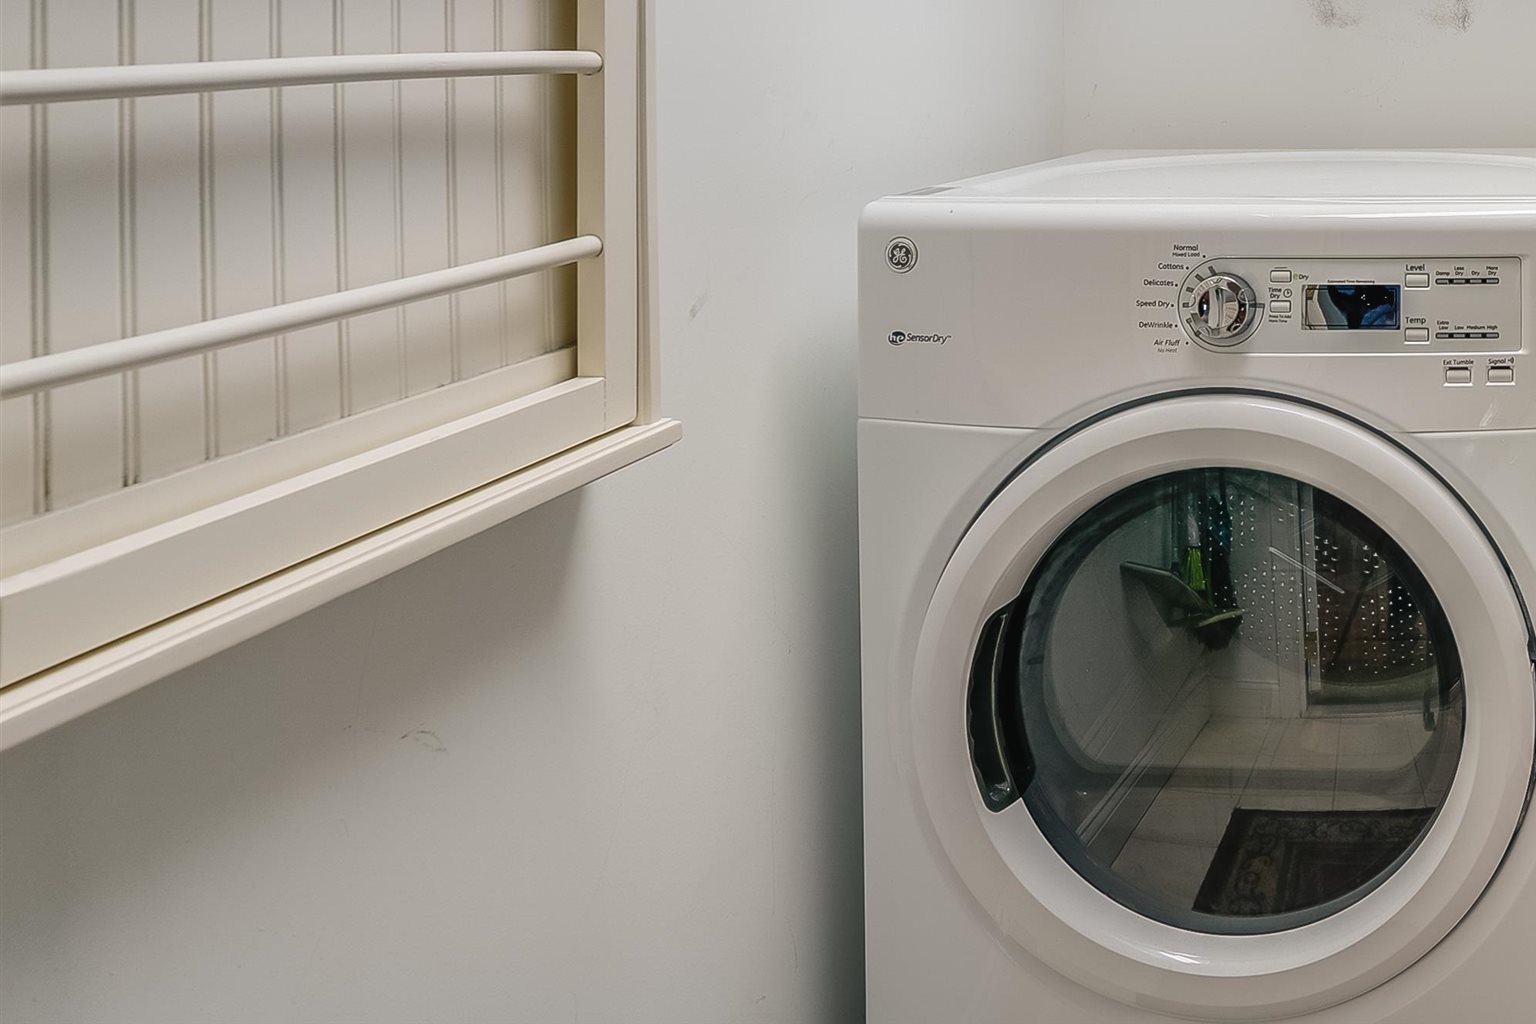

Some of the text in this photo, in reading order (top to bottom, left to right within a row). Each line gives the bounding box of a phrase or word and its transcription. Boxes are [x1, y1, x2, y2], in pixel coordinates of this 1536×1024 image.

[1136, 300, 1170, 308] Speed Dry
[1405, 317, 1426, 325] Temp
[1488, 358, 1506, 366] Signal
